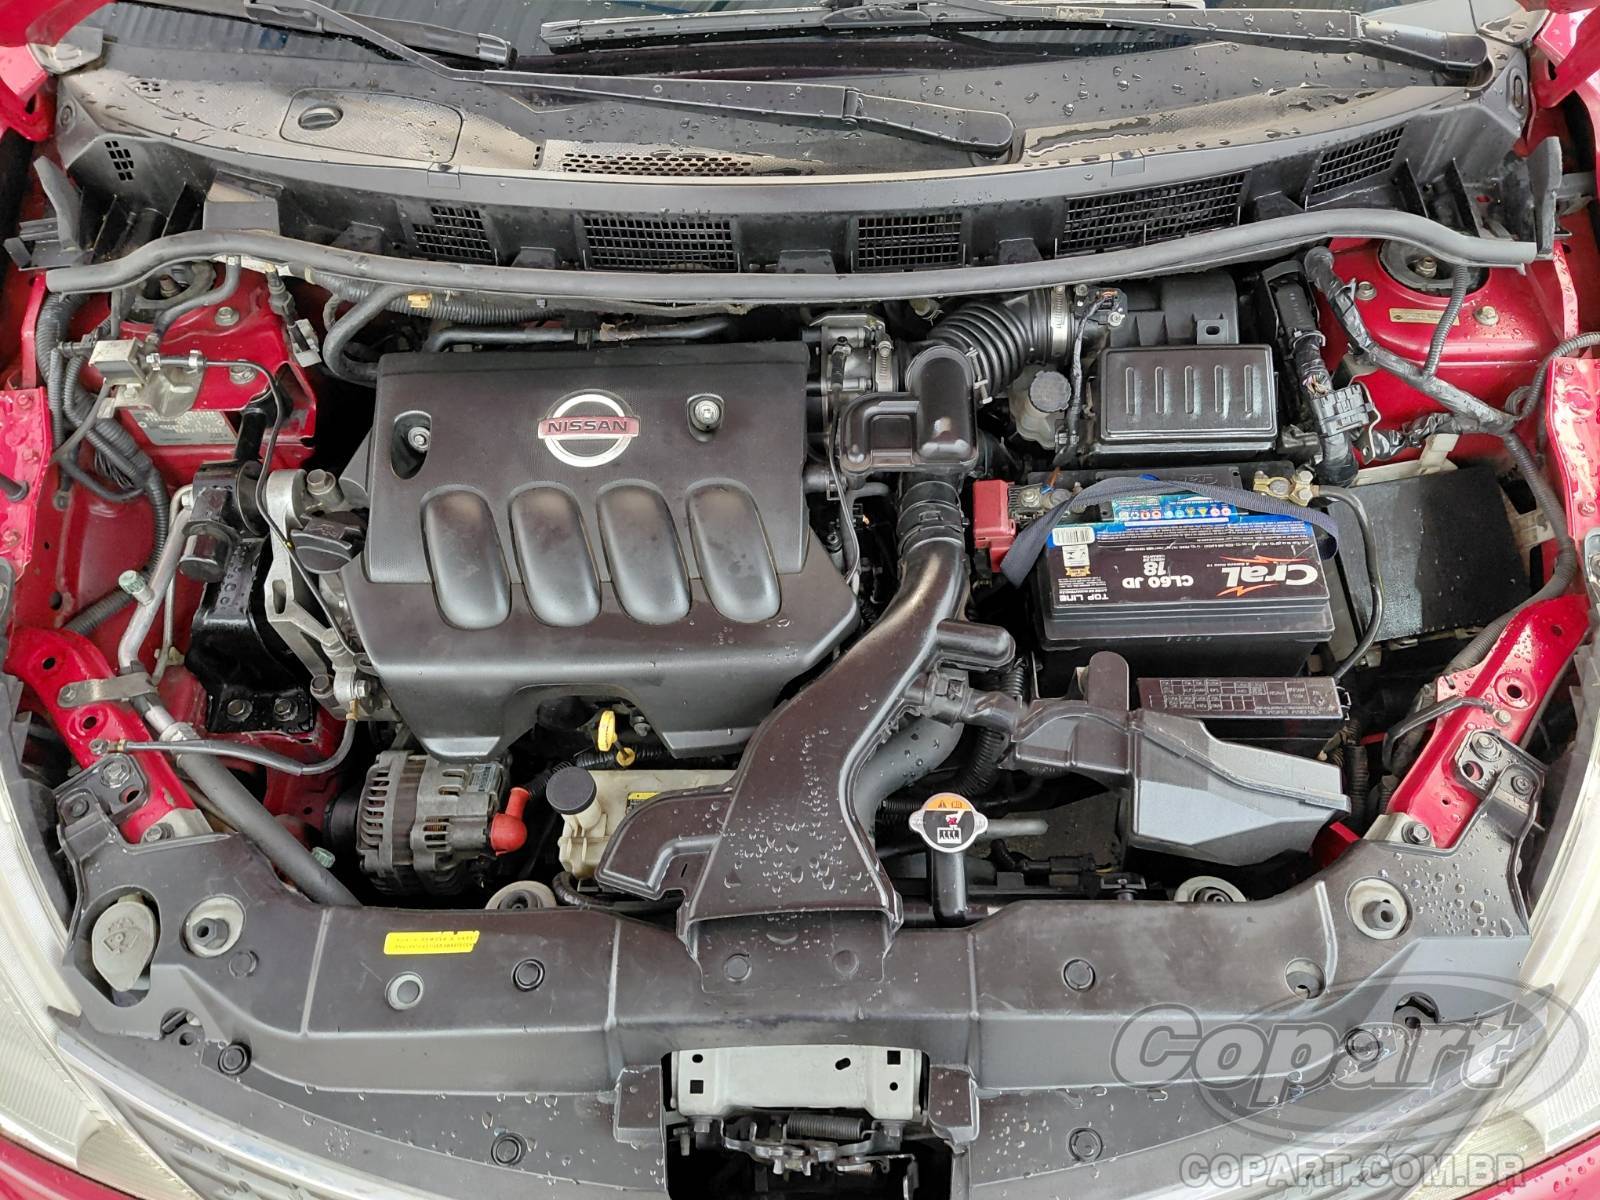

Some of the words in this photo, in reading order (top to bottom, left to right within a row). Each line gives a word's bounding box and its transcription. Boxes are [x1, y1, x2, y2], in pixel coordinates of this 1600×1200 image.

[547, 420, 628, 432] NISSAN
[1143, 562, 1167, 576] 18
[1122, 576, 1145, 589] JD
[1148, 574, 1194, 589] CL60
[1087, 593, 1109, 601] TOP
